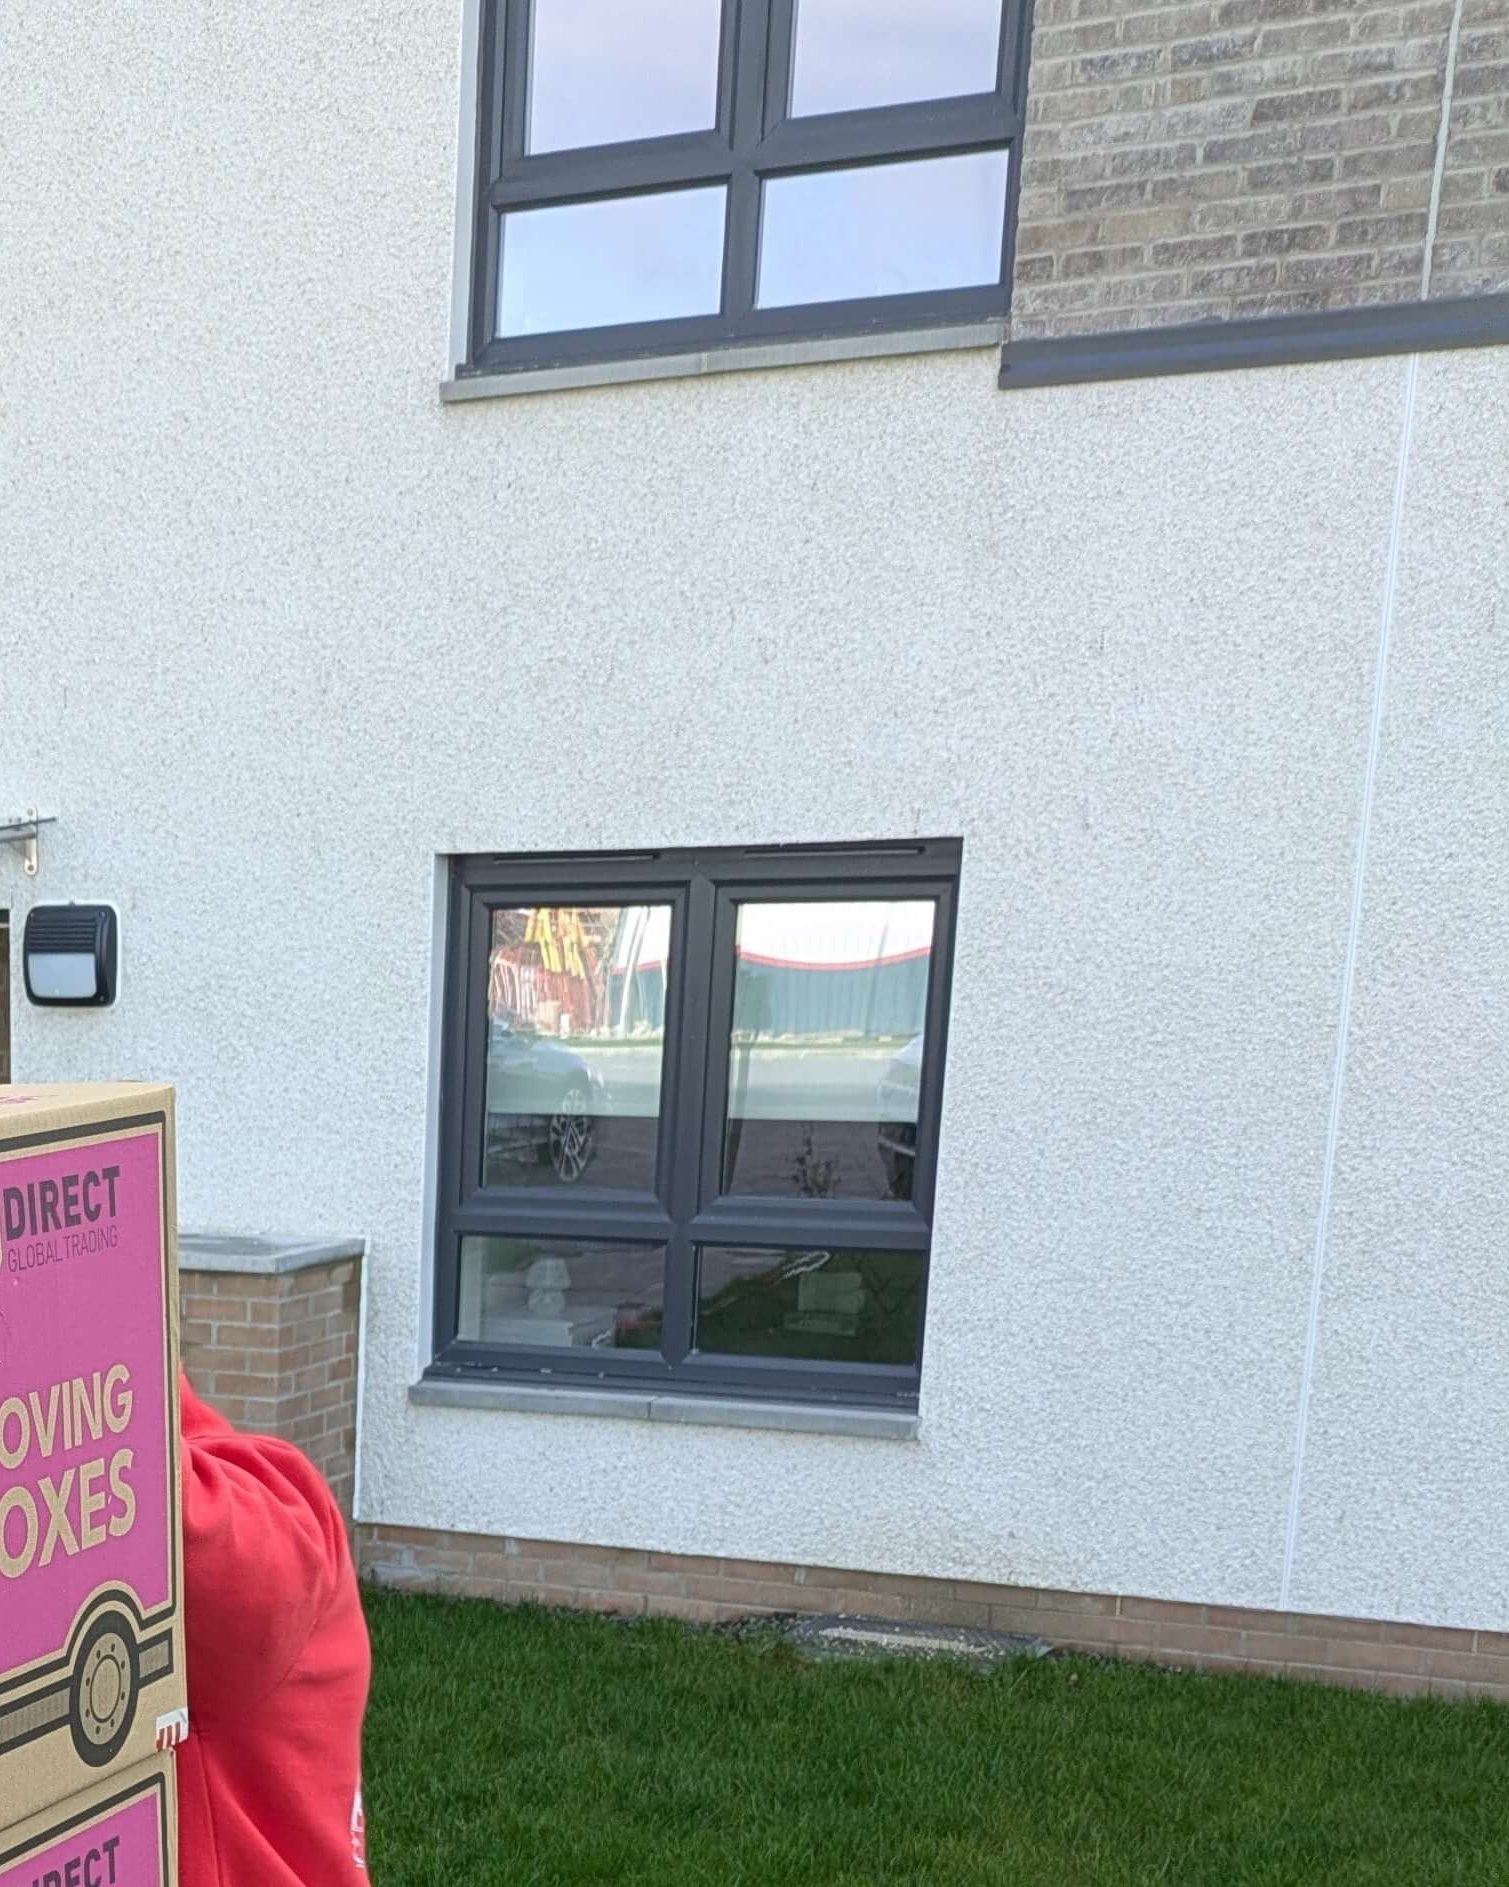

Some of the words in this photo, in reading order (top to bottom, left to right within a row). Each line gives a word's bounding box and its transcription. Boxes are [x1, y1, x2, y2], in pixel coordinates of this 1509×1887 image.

[3, 1166, 120, 1241] DIRECT
[7, 1239, 64, 1272] GLOBAL
[63, 1225, 118, 1259] TRADING
